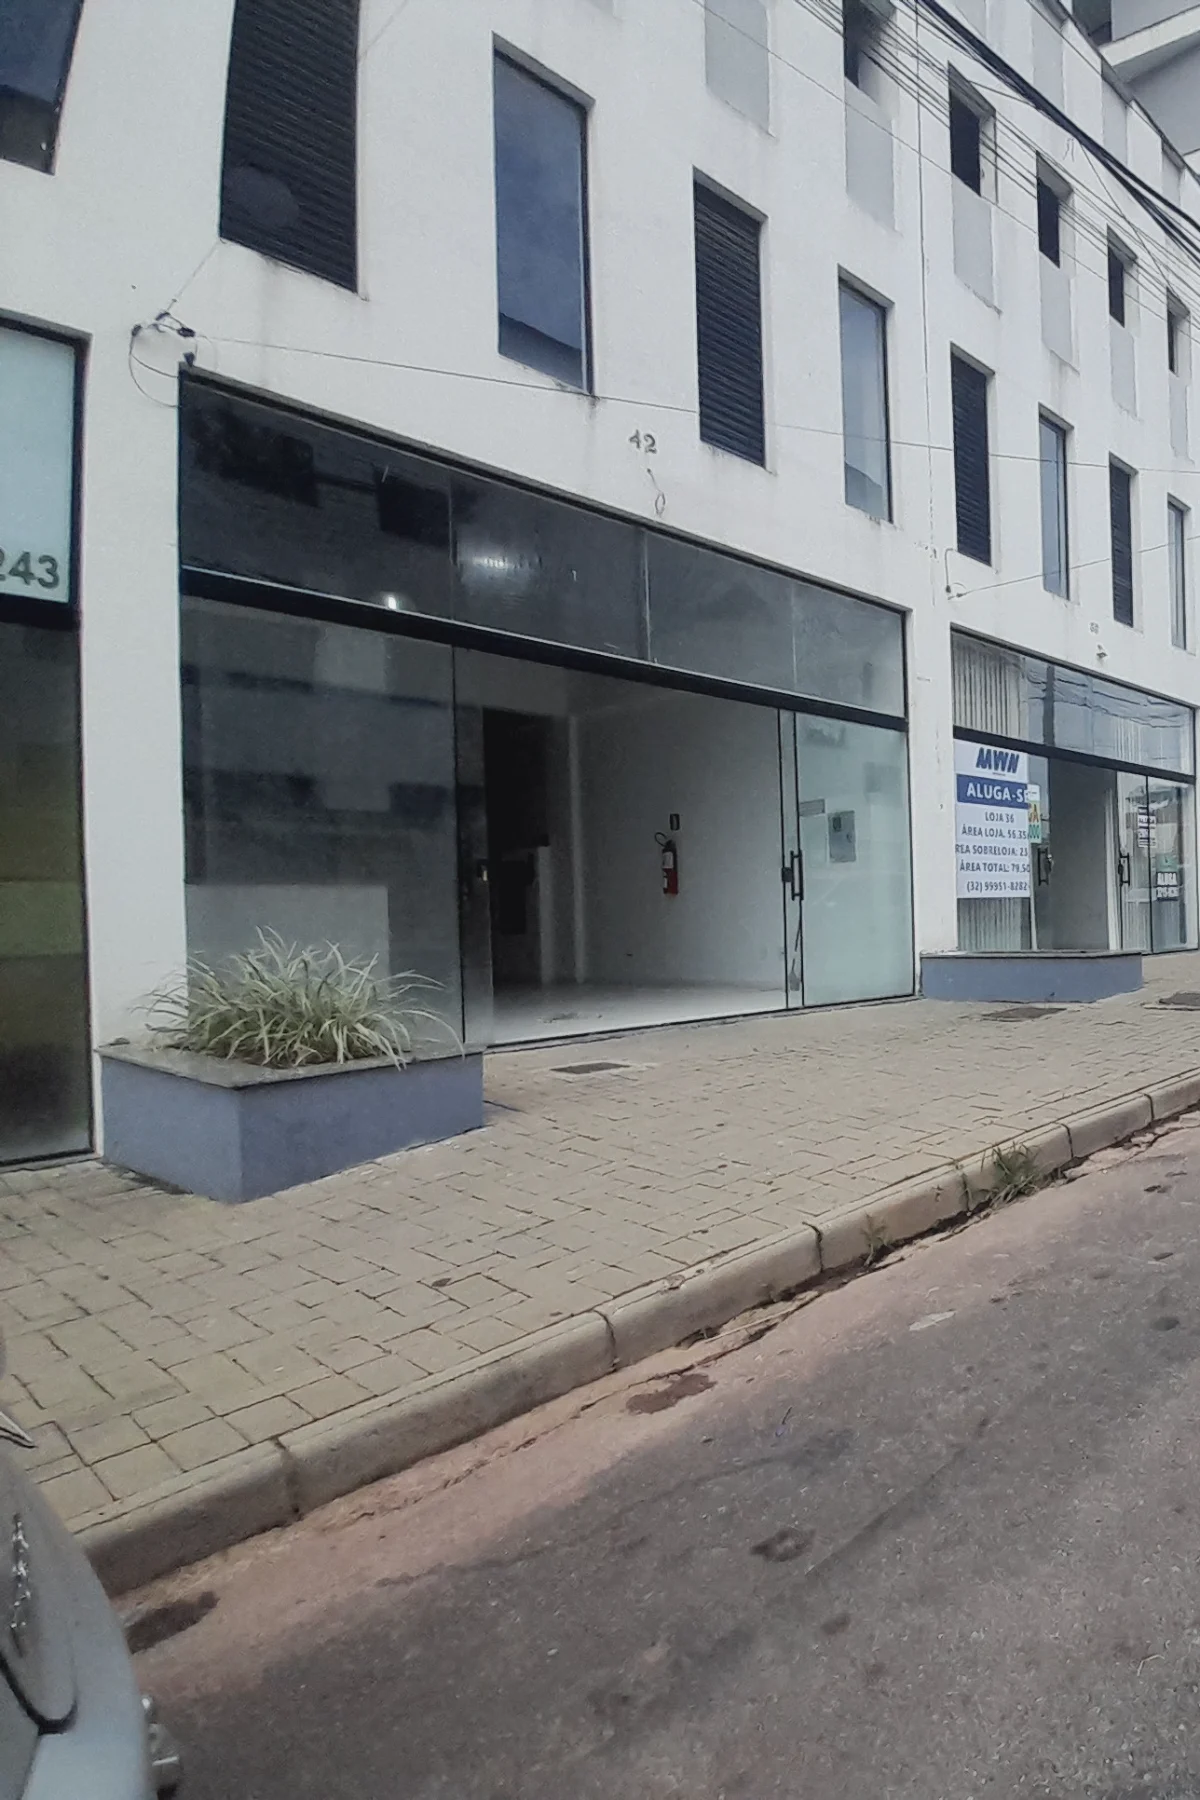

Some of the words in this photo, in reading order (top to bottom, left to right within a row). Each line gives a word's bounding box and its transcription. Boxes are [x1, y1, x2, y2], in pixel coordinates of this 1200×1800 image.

[629, 429, 657, 454] 42
[985, 812, 1004, 822] LOJA
[962, 824, 983, 837] ÁREA
[960, 859, 981, 872] ÁREA
[966, 881, 983, 893] (32)
